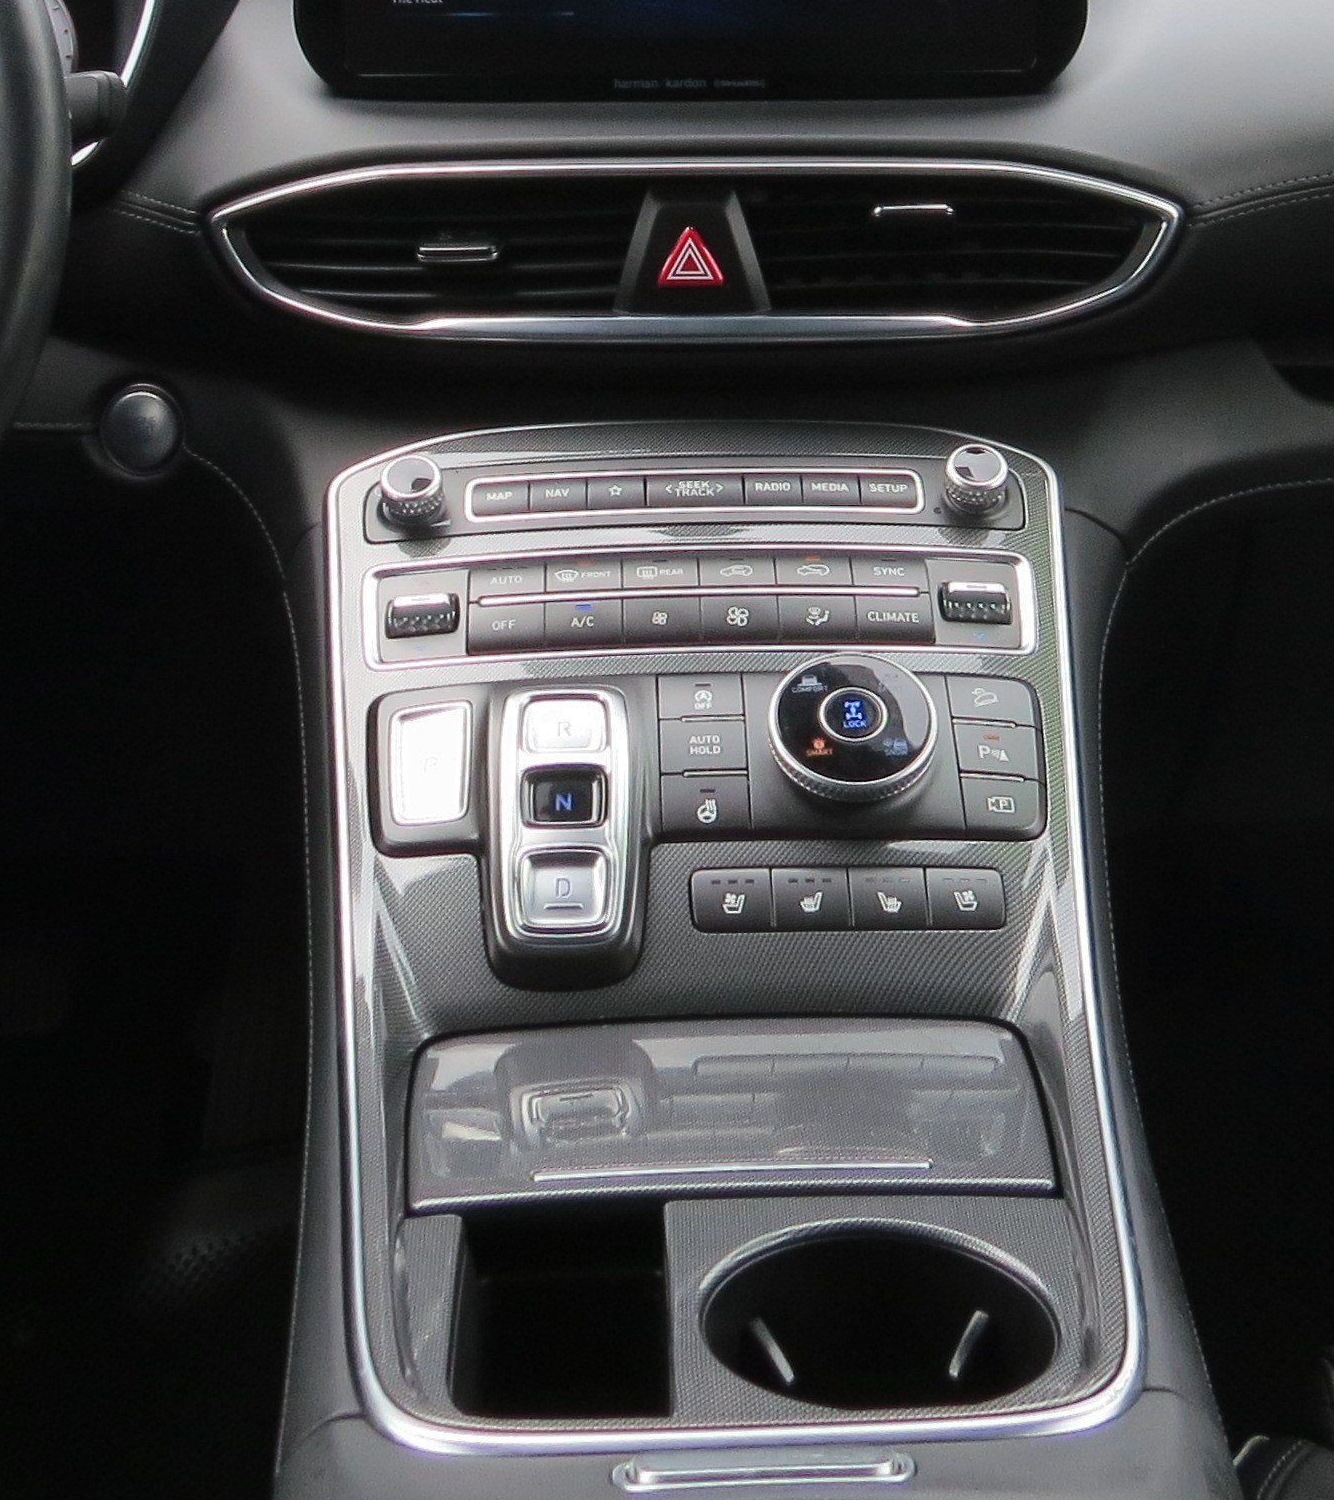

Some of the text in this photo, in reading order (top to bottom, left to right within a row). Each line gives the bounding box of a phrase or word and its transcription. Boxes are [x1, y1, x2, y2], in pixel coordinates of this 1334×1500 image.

[614, 78, 659, 89] harman
[665, 77, 707, 89] kardon
[678, 480, 711, 489] SEEK
[755, 482, 791, 492] RADIO
[811, 482, 850, 493] MEDIA
[869, 483, 908, 493] SETUP
[486, 491, 513, 502] MAP
[545, 487, 570, 498] NAV
[675, 488, 716, 497] TRACK
[580, 570, 611, 579] FRONT
[659, 568, 685, 576] REAR
[873, 566, 905, 576] SYNC
[490, 575, 523, 585] AUTO
[570, 616, 595, 628] A/C
[867, 611, 920, 623] CLIMATE
[492, 619, 517, 631] OFF
[791, 685, 829, 694] COMFORT
[694, 699, 712, 711] OFF
[557, 721, 572, 737] R
[842, 719, 867, 729] LOCK
[689, 734, 721, 745] AUTO
[689, 744, 721, 755] HOLD
[806, 747, 833, 757] SMART
[555, 792, 573, 811] N
[554, 877, 571, 898] D
